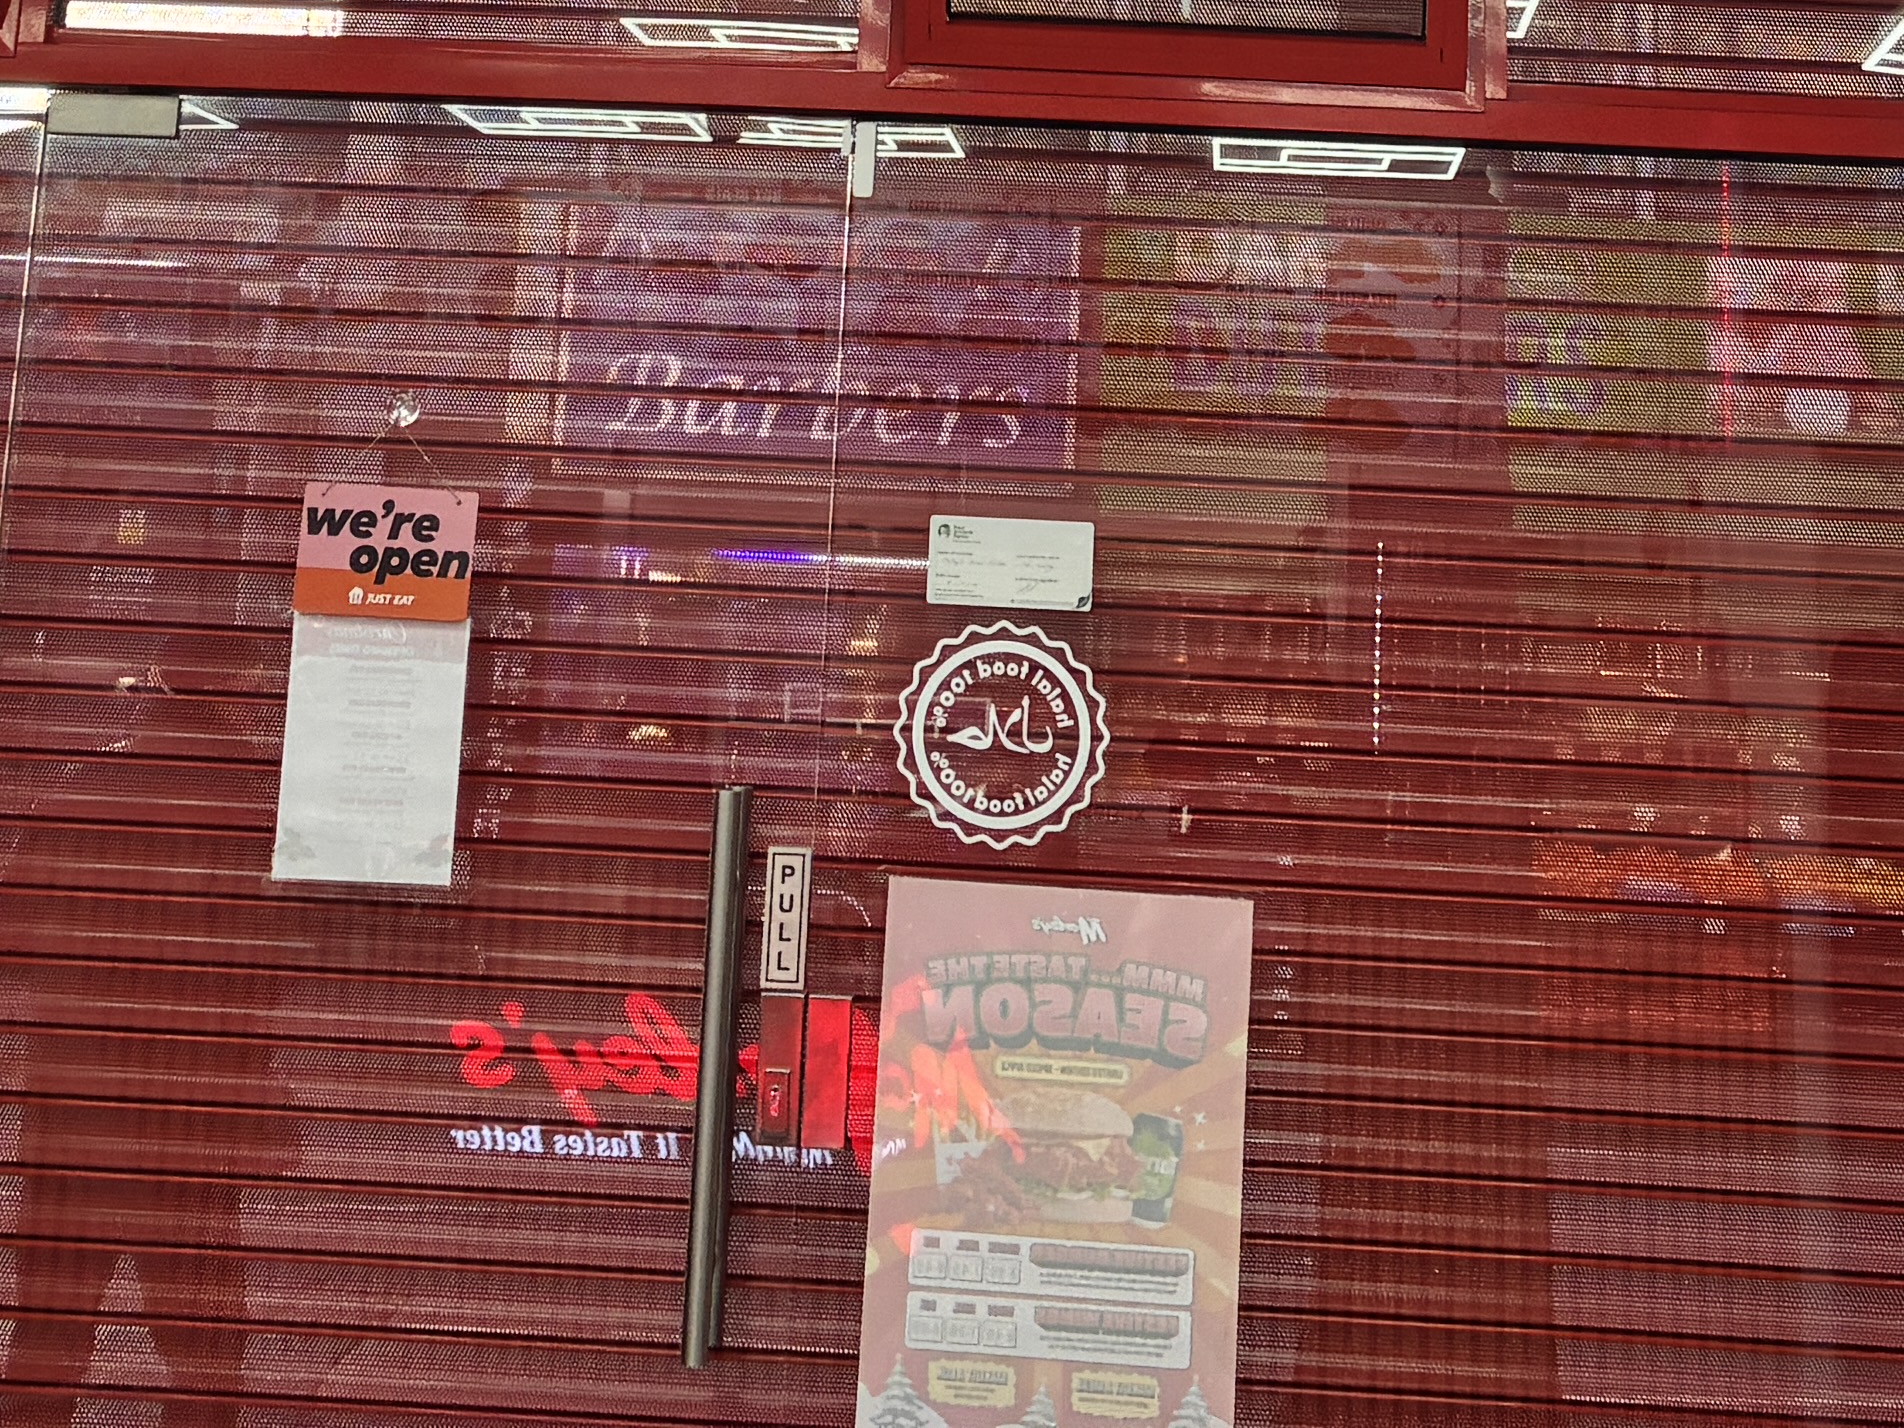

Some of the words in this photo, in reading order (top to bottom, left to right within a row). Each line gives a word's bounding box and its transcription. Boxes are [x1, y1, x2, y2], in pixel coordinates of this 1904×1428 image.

[604, 353, 1029, 448] Barbers
[307, 499, 441, 543] we're
[349, 544, 470, 585] open
[366, 593, 392, 605] JUST
[392, 594, 416, 606] EAT
[776, 864, 797, 975] PULL
